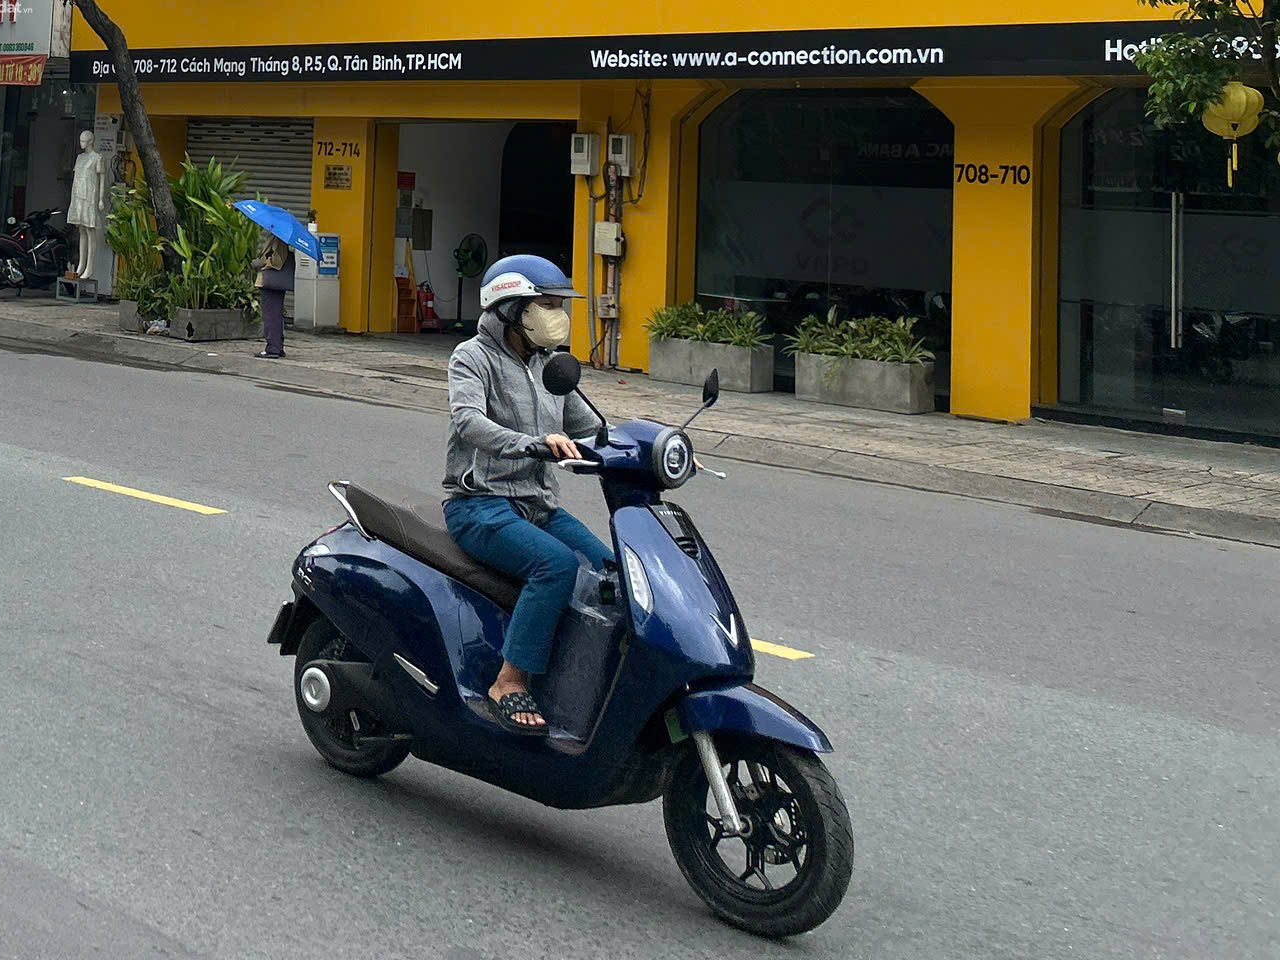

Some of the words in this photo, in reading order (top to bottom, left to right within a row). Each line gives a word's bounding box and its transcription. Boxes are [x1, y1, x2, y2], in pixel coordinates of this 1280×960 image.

[92, 60, 109, 78] Địa
[133, 58, 177, 74] 708-712
[180, 57, 210, 74] Cách
[213, 57, 246, 77] Mạng
[250, 55, 290, 76] Tháng
[591, 48, 668, 69] Website:
[672, 44, 944, 69] www.a-connection.com.vn
[317, 141, 361, 158] 712-714
[955, 163, 1031, 185] 708-710
